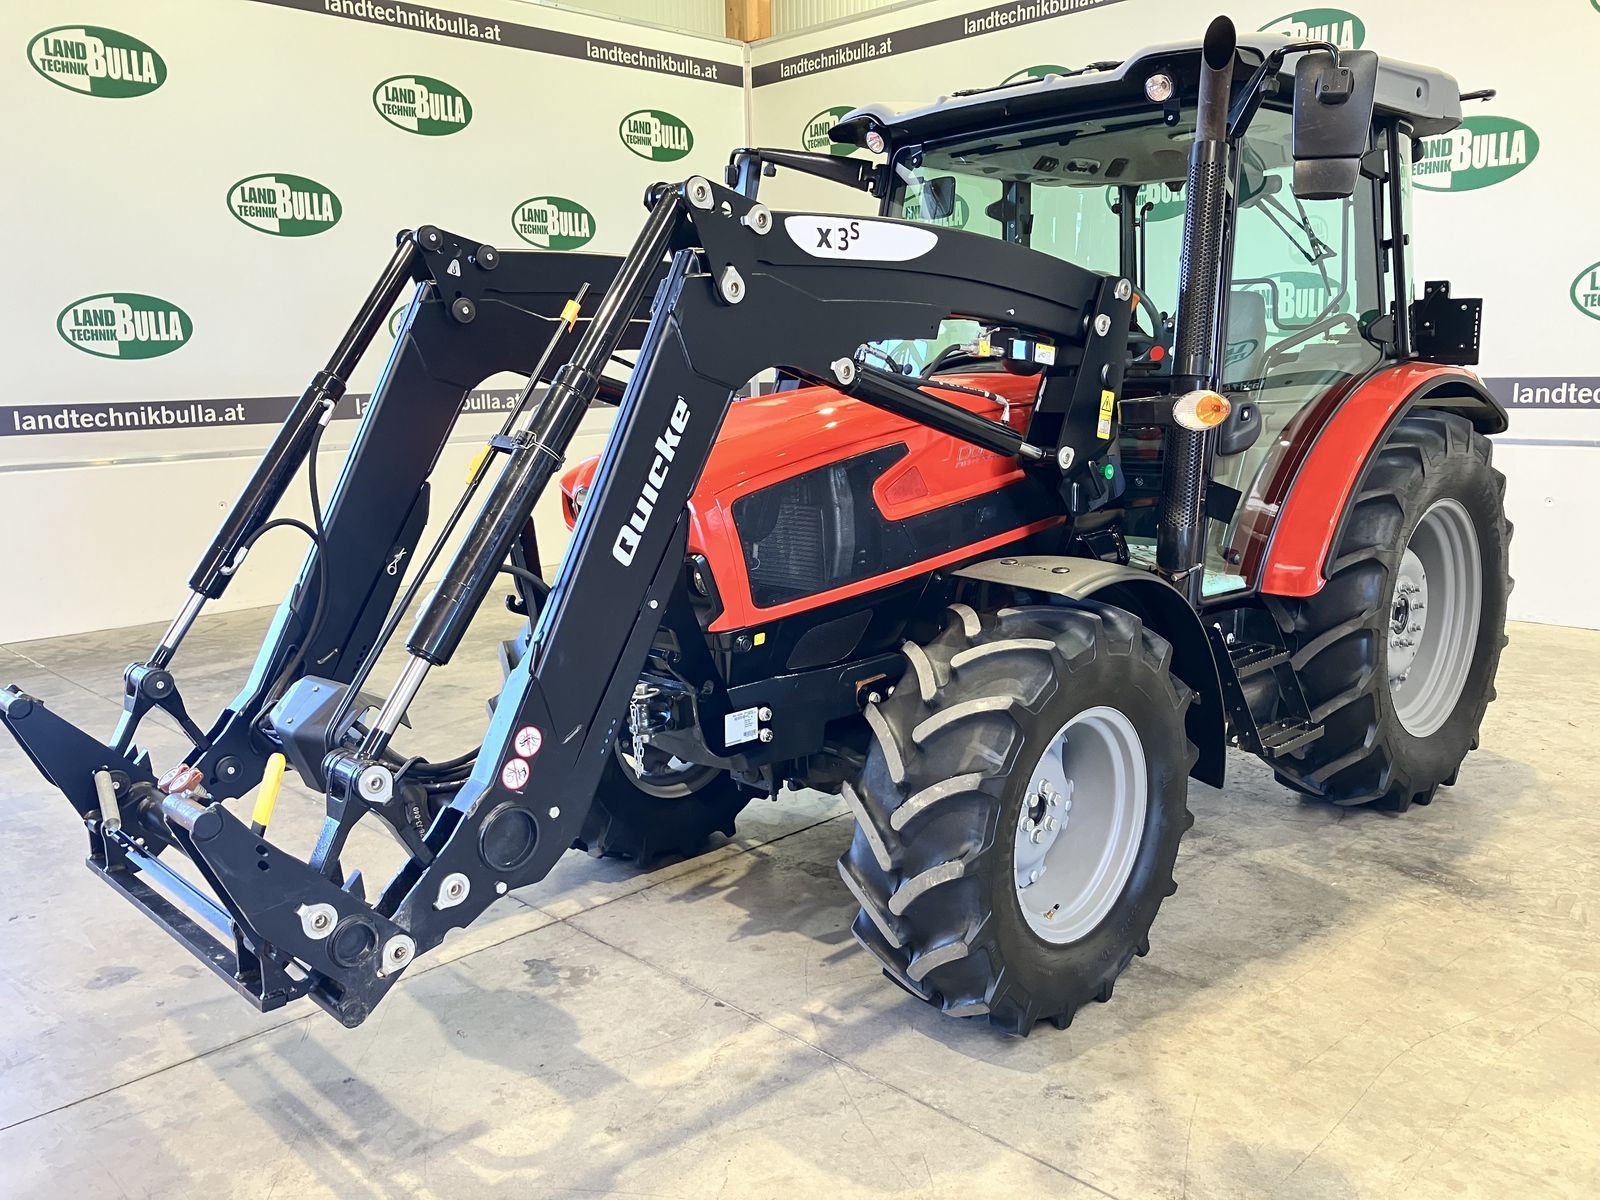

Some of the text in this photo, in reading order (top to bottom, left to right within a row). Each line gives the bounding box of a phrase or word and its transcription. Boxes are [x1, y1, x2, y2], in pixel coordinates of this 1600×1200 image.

[324, 0, 501, 41] landtechnikbulla.at
[43, 37, 88, 60] LAND
[780, 38, 893, 78] landtechnikbulla.at
[40, 58, 90, 76] TECHNIK
[87, 35, 158, 84] BULLA
[586, 41, 718, 79] landtechnikbulla.at
[384, 86, 416, 104] LAND
[415, 84, 466, 124] BULLA
[381, 103, 417, 118] TECHNIK
[628, 119, 651, 135] LAND
[651, 117, 689, 151] BULLA
[809, 122, 830, 138] LAND
[626, 134, 652, 147] TECHNIK
[1423, 138, 1453, 159] AND
[1452, 128, 1527, 172] BULLA
[1412, 159, 1453, 176] ECHNIK
[240, 186, 277, 205] LAND
[277, 182, 335, 222] BULLA
[237, 204, 279, 219] TECHNIK
[521, 207, 548, 223] LAND
[547, 204, 591, 238] BULLA
[518, 223, 549, 235] TECHNIK
[73, 308, 116, 327] LAND
[116, 302, 184, 342] BULLA
[69, 328, 119, 341] TECHNIK
[13, 403, 246, 431] landtechnikbulla.at
[612, 398, 691, 568] Quicke
